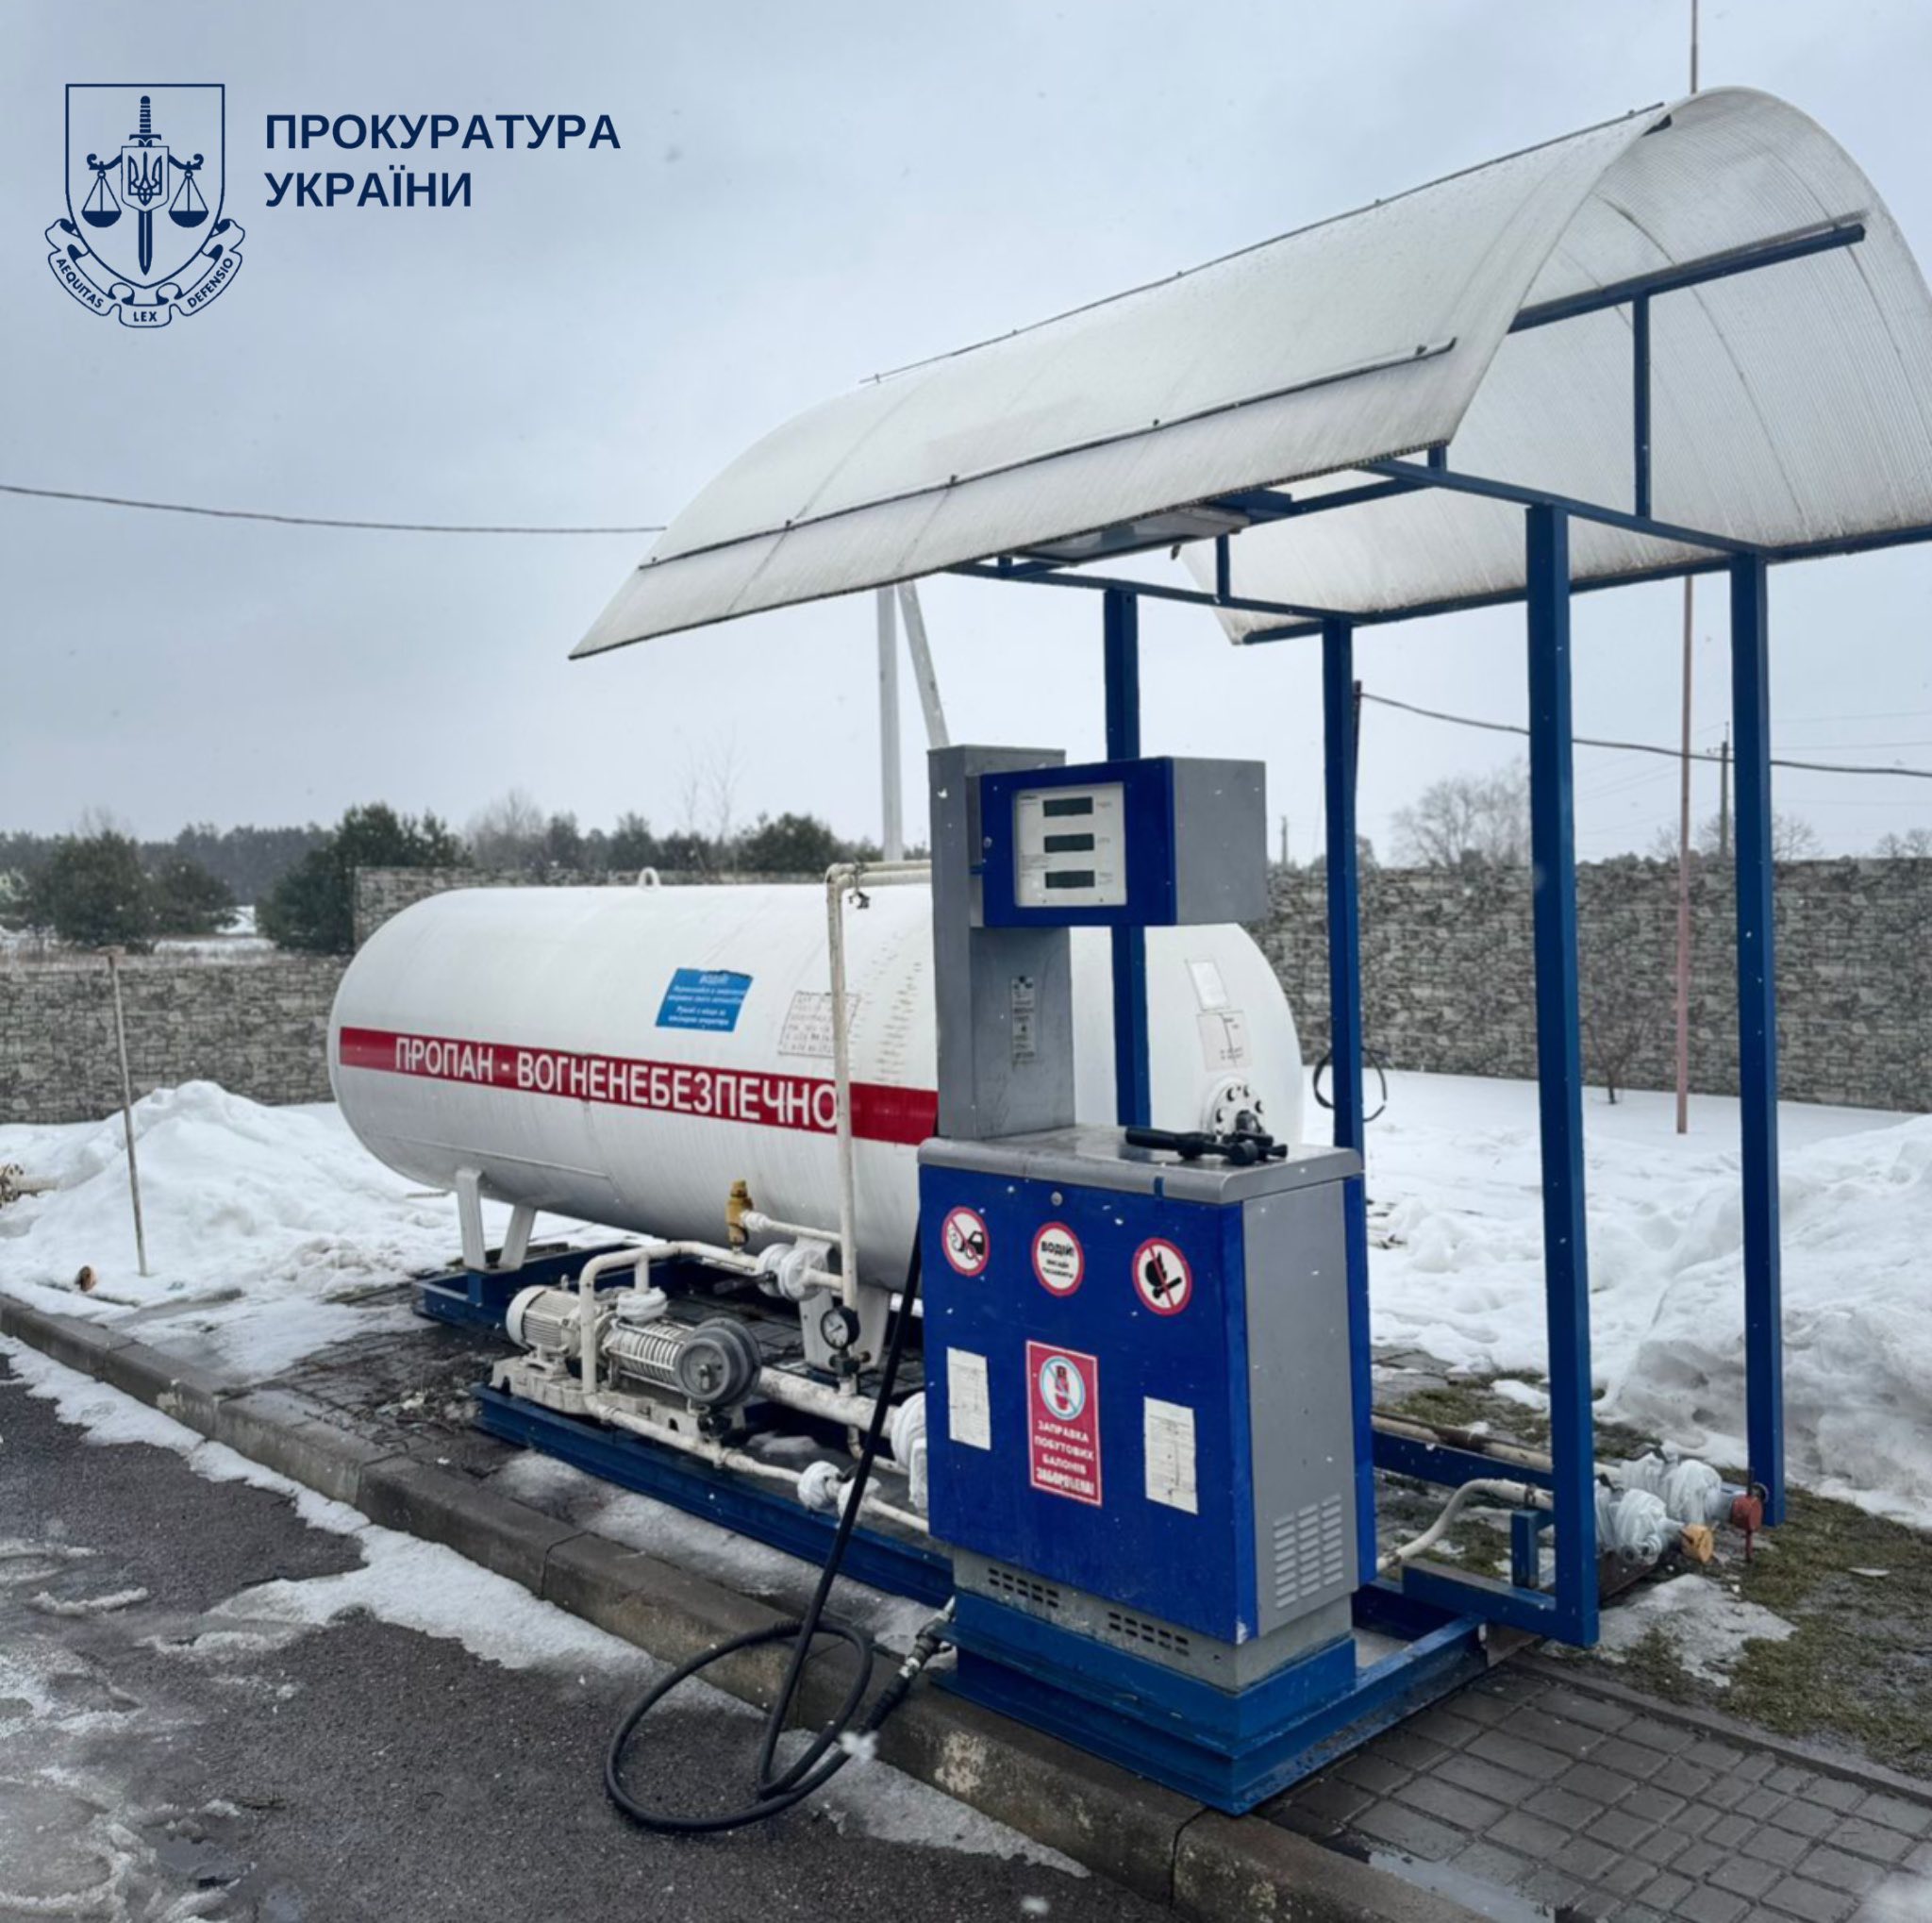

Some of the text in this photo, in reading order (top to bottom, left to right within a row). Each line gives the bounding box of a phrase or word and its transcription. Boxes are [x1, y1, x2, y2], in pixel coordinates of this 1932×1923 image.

[395, 1037, 493, 1082] ПРОПАН
[516, 1051, 838, 1129] ВОГНЕНЕБЕЗПЕЧНО
[1038, 1419, 1090, 1443] ЗАПРАВКА
